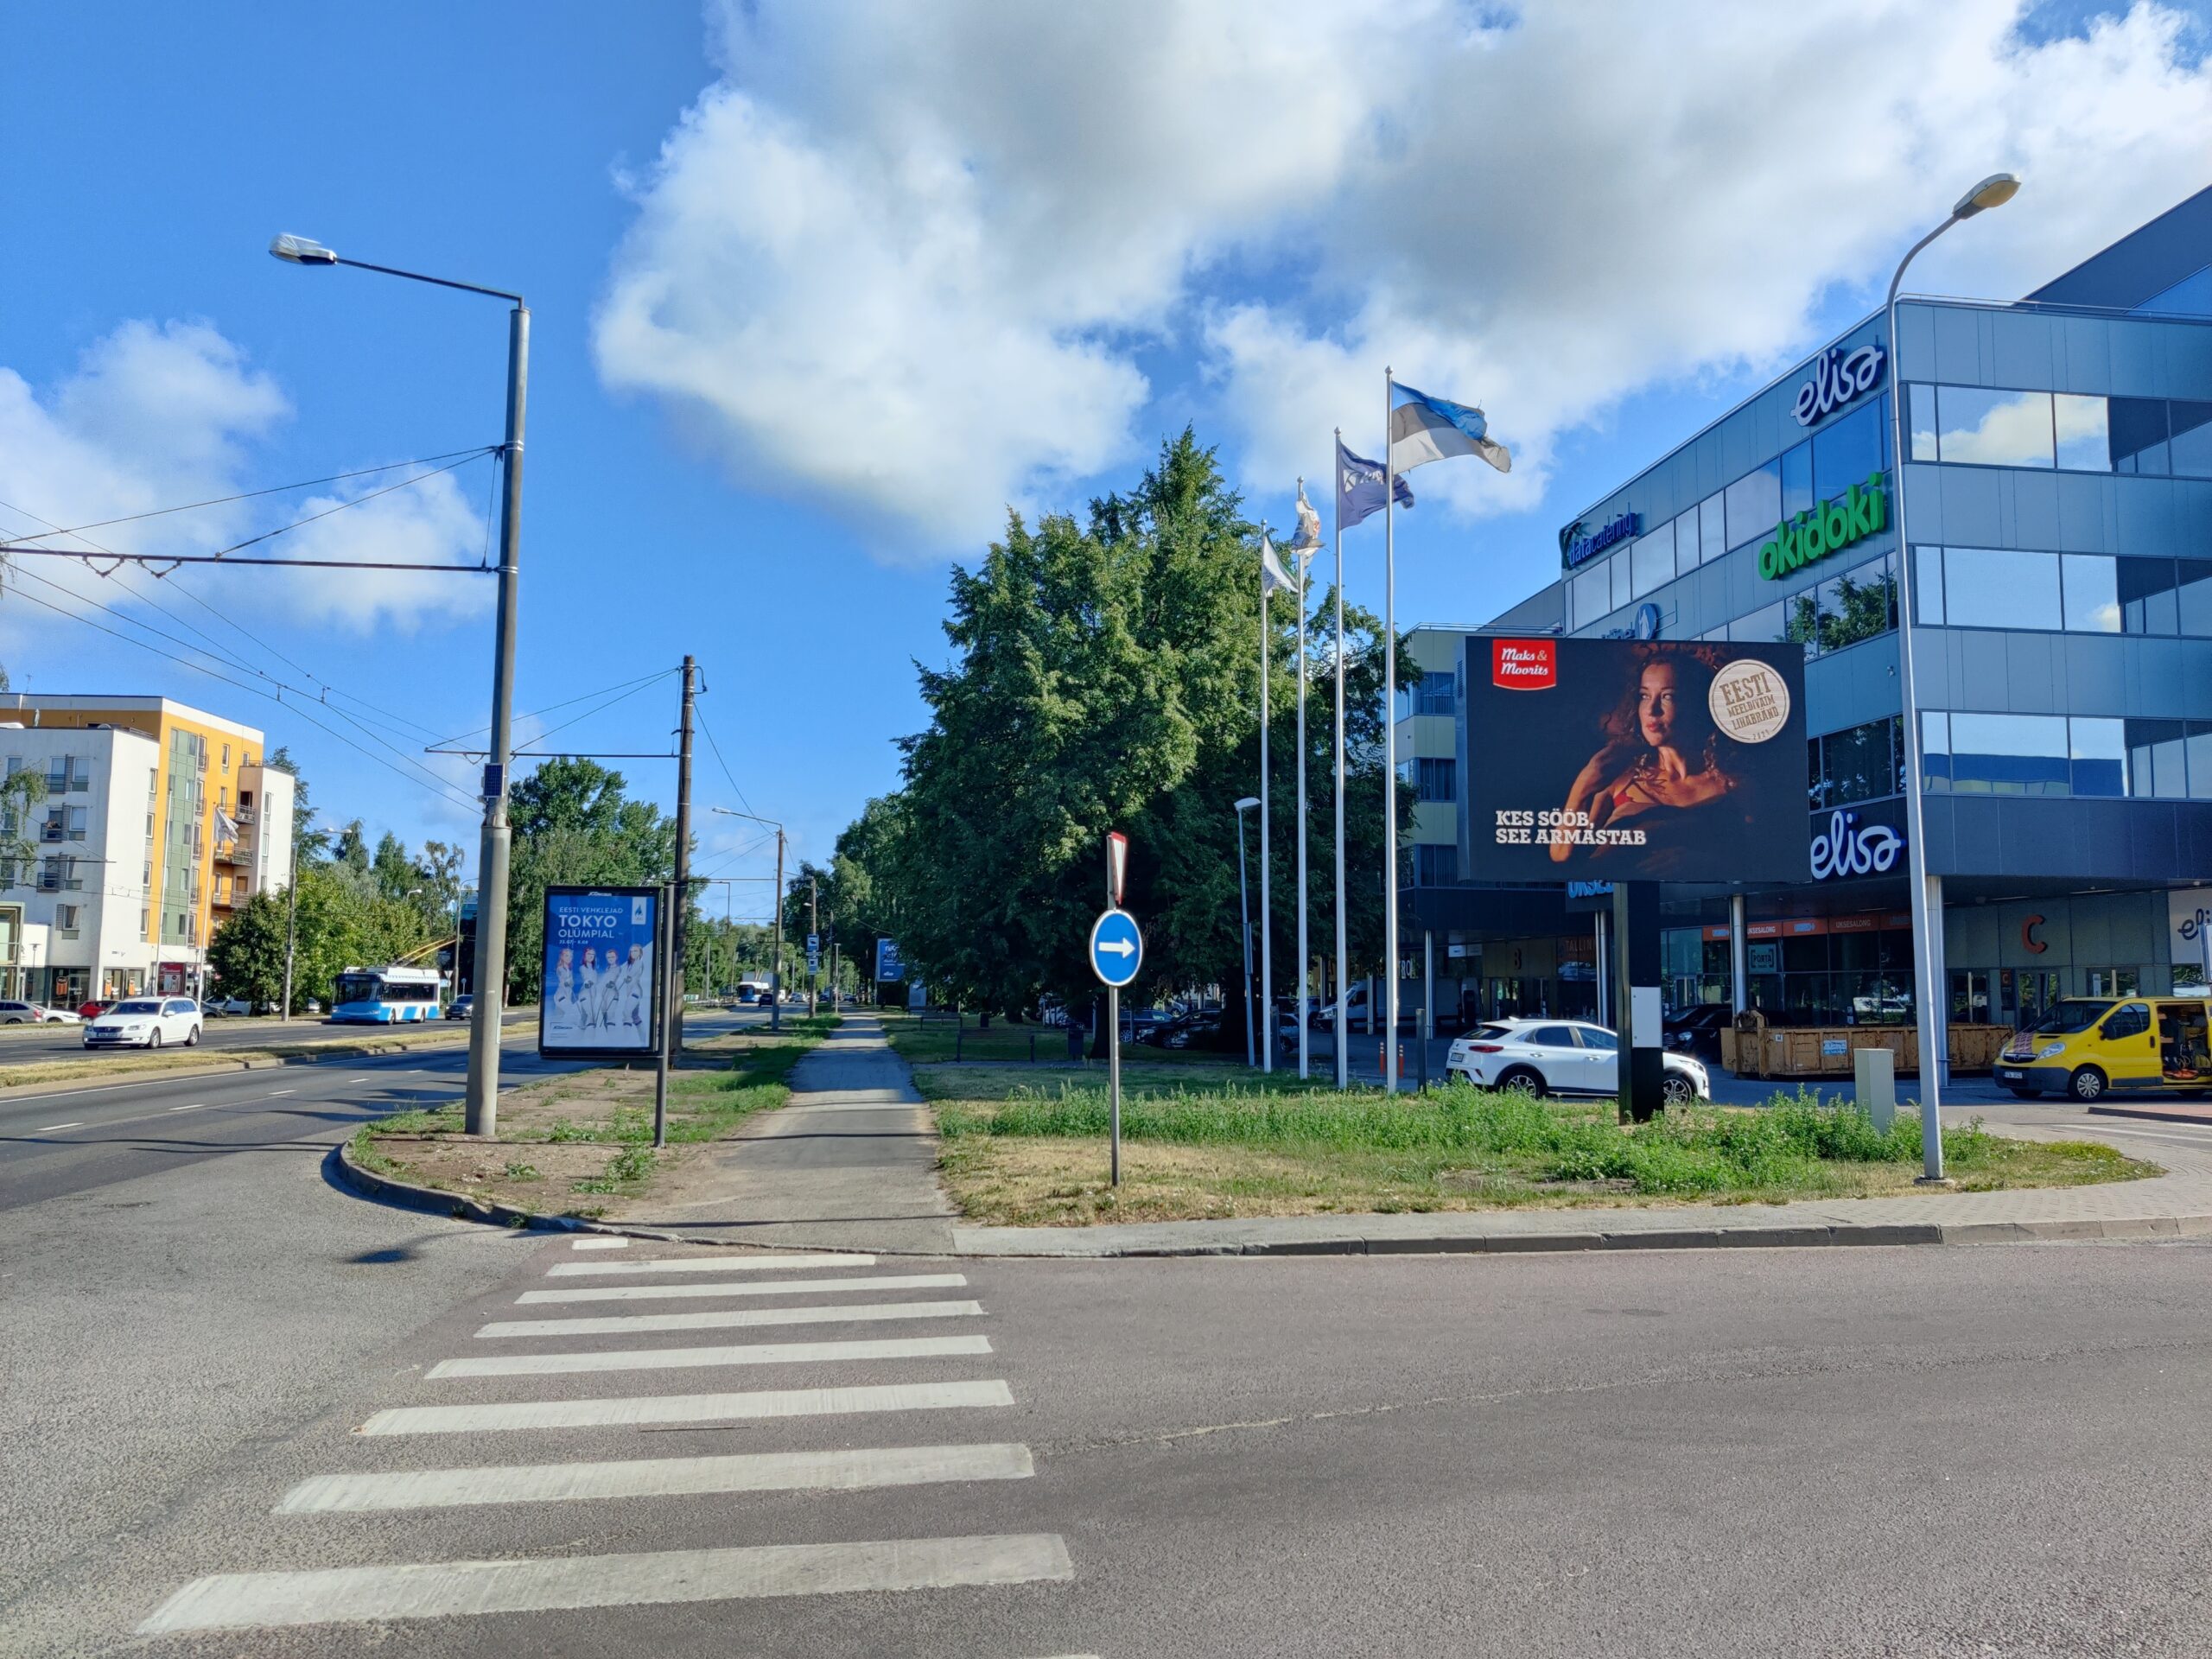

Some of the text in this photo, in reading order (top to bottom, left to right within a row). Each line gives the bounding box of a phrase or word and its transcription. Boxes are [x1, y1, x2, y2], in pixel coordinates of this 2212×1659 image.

[1790, 345, 1885, 427] elisa
[1758, 471, 1885, 582] okidoki
[1568, 513, 1634, 568] datacatering
[1501, 647, 1548, 661] Maks &
[1500, 662, 1548, 676] Moorits
[1719, 671, 1771, 706] EESTI
[1727, 694, 1776, 718] MEELDIVAIM
[1731, 706, 1779, 730] LIHABRÄND
[1496, 807, 1595, 830] KES SÖÖB,
[1496, 829, 1647, 845] SEE ARMASTAB
[1810, 810, 1902, 880] elisa
[558, 914, 617, 928] TOKYO
[558, 927, 614, 938] OLÜMPIAL
[2021, 914, 2048, 955] C
